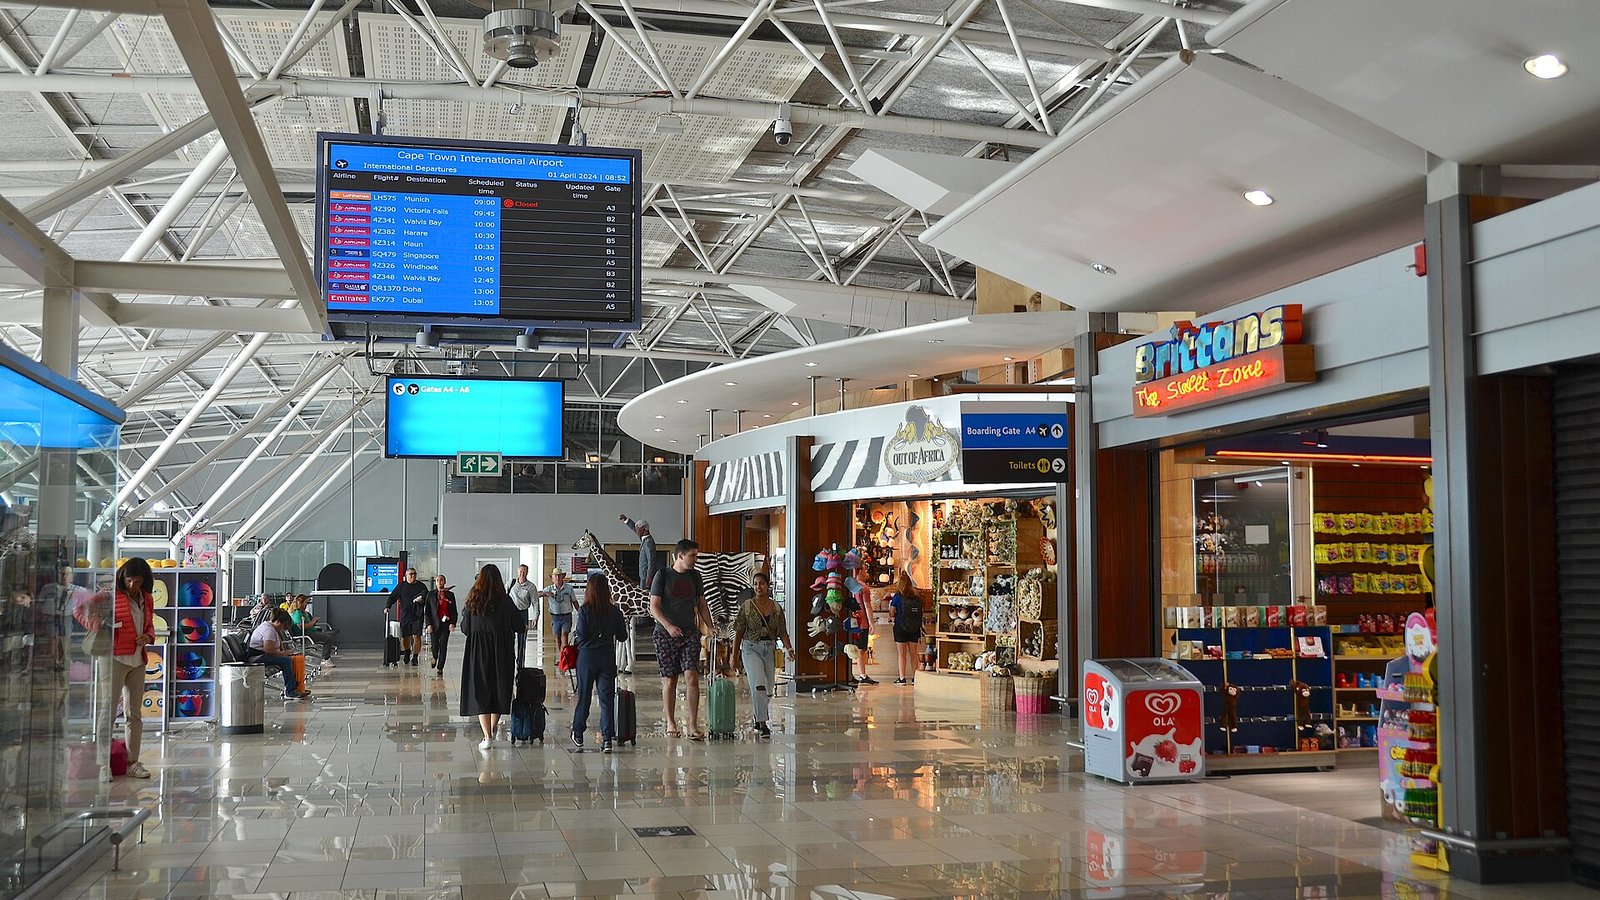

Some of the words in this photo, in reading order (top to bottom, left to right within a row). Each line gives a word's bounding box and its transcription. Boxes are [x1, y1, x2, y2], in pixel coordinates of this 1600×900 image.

[398, 151, 424, 160] Cape
[427, 152, 456, 162] Town
[460, 154, 525, 165] International
[529, 158, 564, 167] Airport
[364, 162, 412, 171] International
[416, 164, 457, 173] Departures
[1135, 304, 1288, 385] Brittans
[1136, 386, 1161, 407] The
[1166, 371, 1210, 400] Sweet
[1218, 359, 1264, 388] Zone
[967, 427, 1001, 437] Boarding
[893, 453, 908, 466] OUT
[908, 452, 918, 464] OF
[918, 447, 944, 464] AFRICA
[1009, 462, 1036, 470] Toilets
[1153, 717, 1174, 726] OLA
